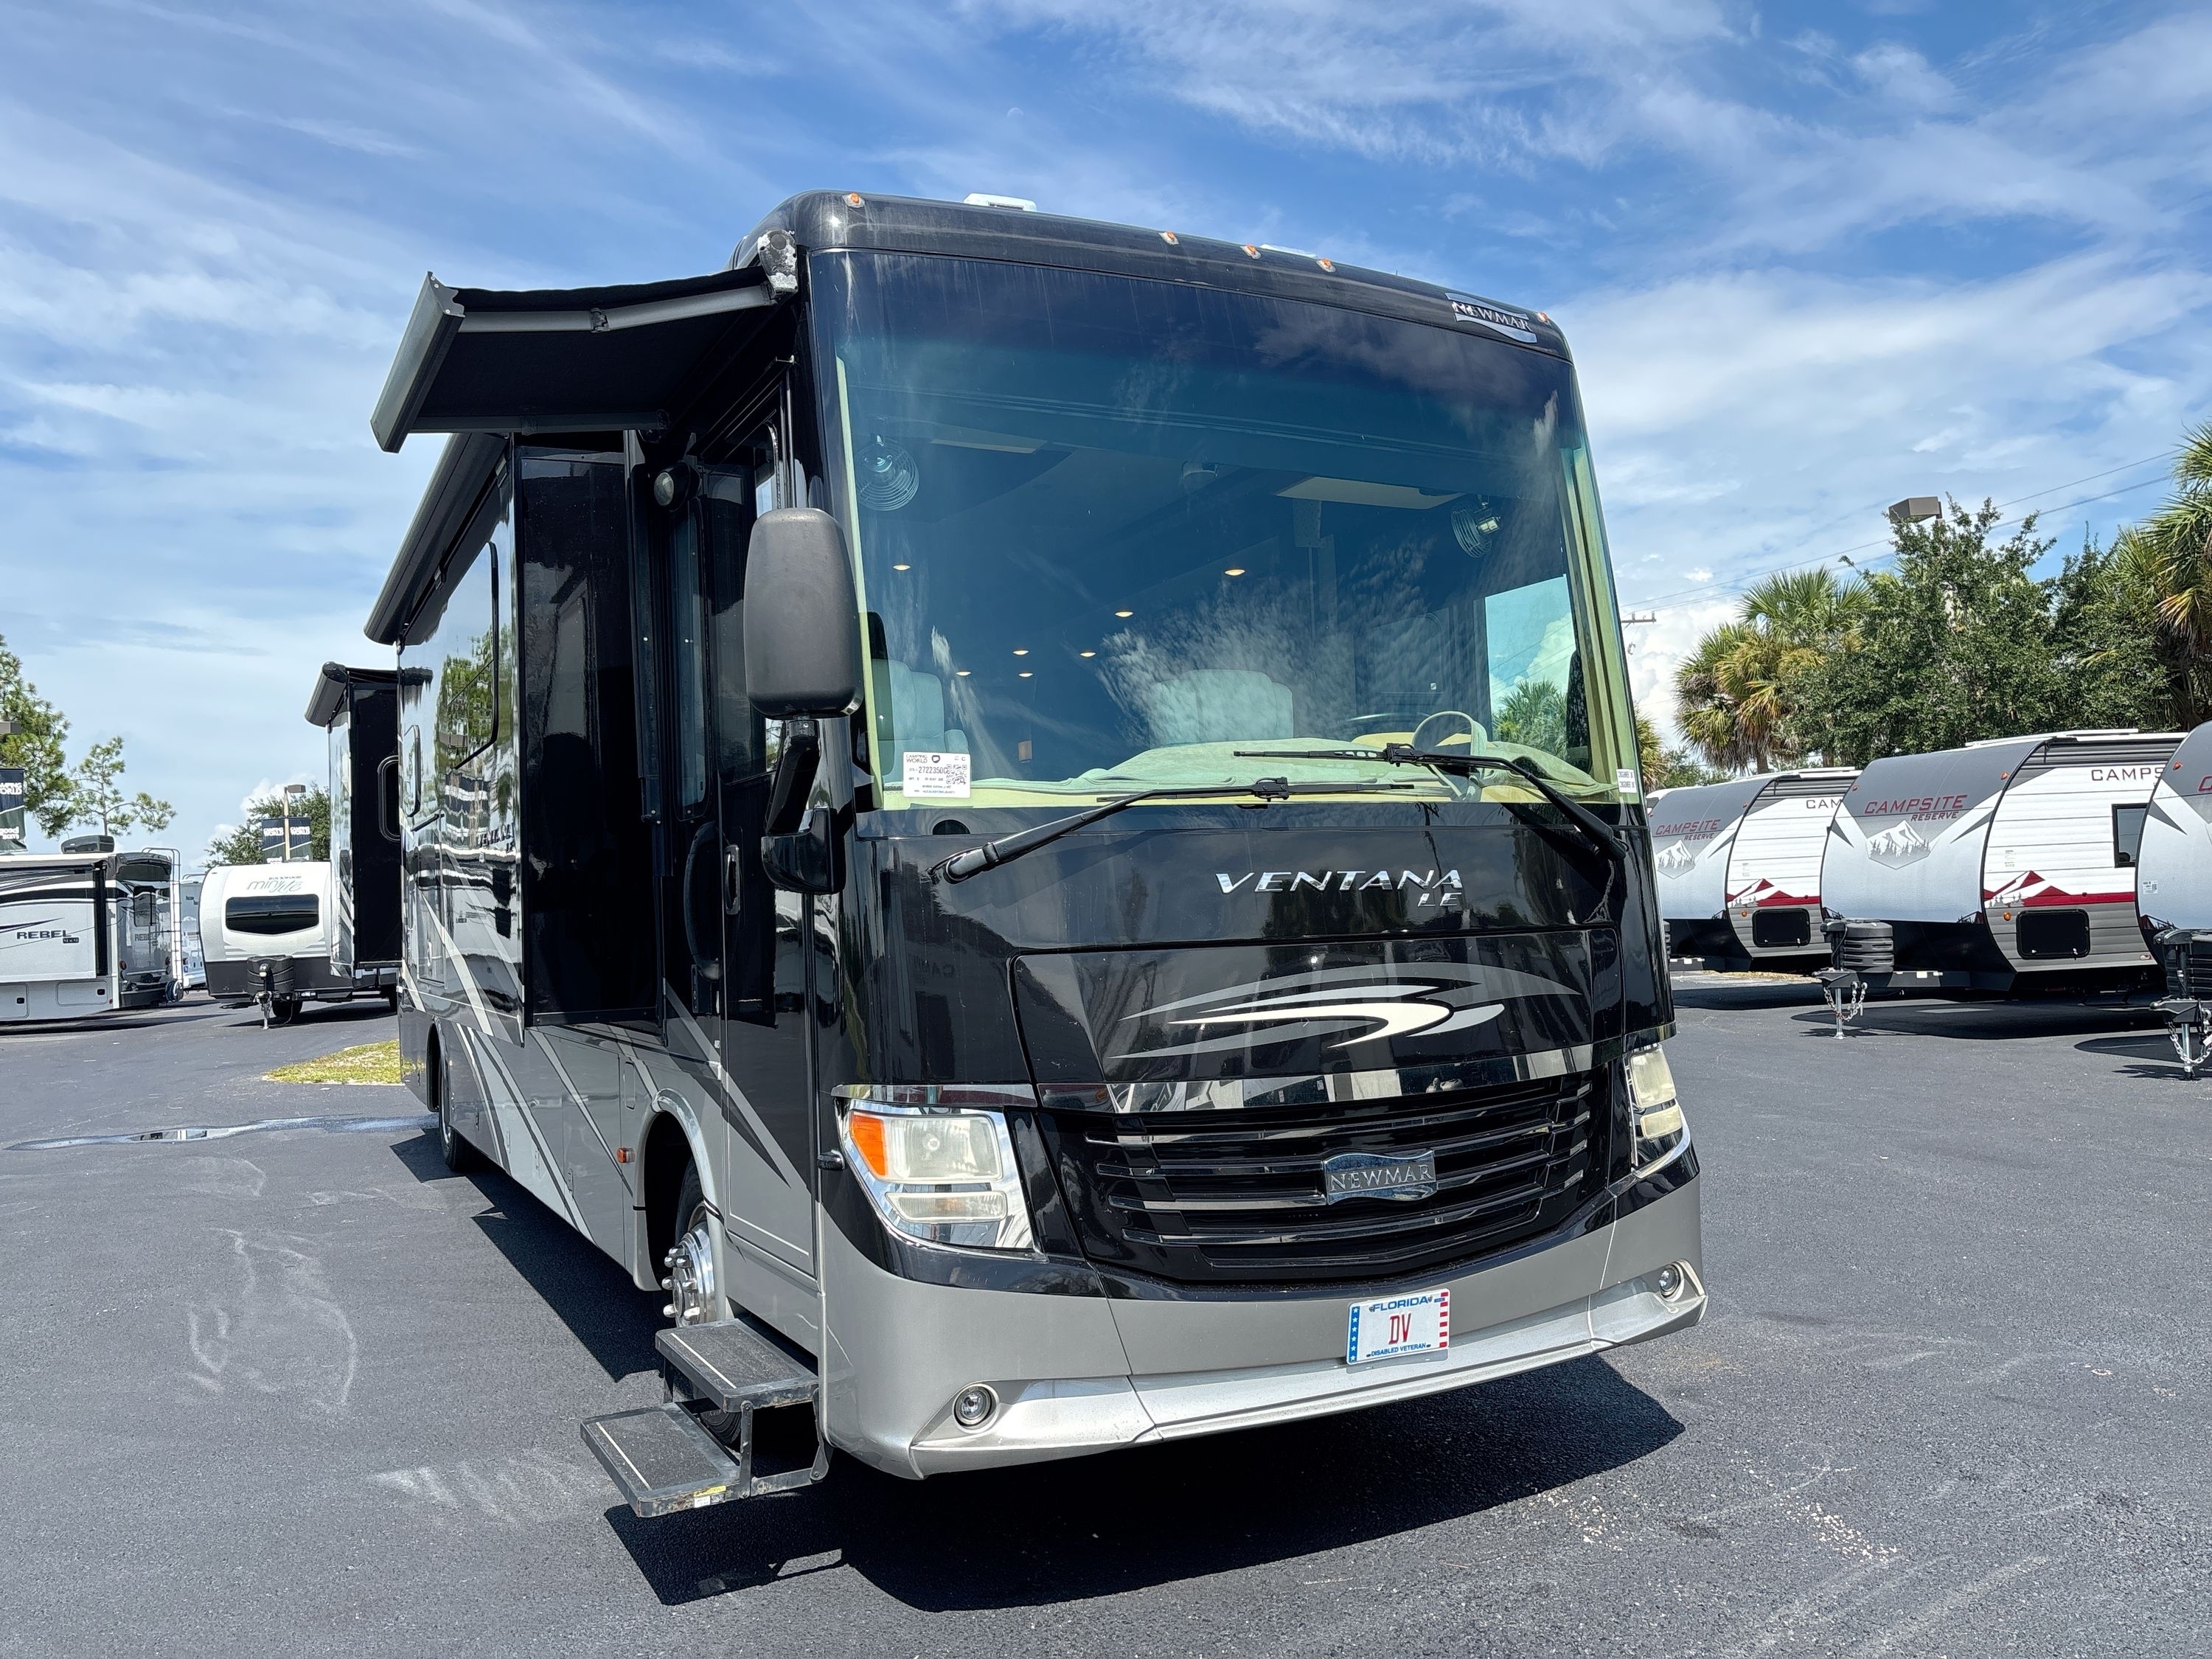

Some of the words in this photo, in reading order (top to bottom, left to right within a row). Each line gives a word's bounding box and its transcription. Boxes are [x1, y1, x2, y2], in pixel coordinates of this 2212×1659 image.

[1451, 301, 1534, 333] NEWMAR
[1863, 794, 1969, 815] CAMPSITE
[1910, 810, 1959, 822] RESERVE
[1655, 819, 1722, 835] CAMPSITE
[1683, 832, 1715, 841] RESERVE
[1214, 869, 1463, 894] VENTANA
[1416, 891, 1462, 908] LE
[16, 930, 72, 939] REBEL
[1329, 1164, 1434, 1192] NEWMAR
[1373, 1295, 1429, 1312] FLORIDA
[1388, 1312, 1411, 1345] DV
[1371, 1347, 1399, 1357] DISABLED
[1400, 1343, 1426, 1352] VETERAN
